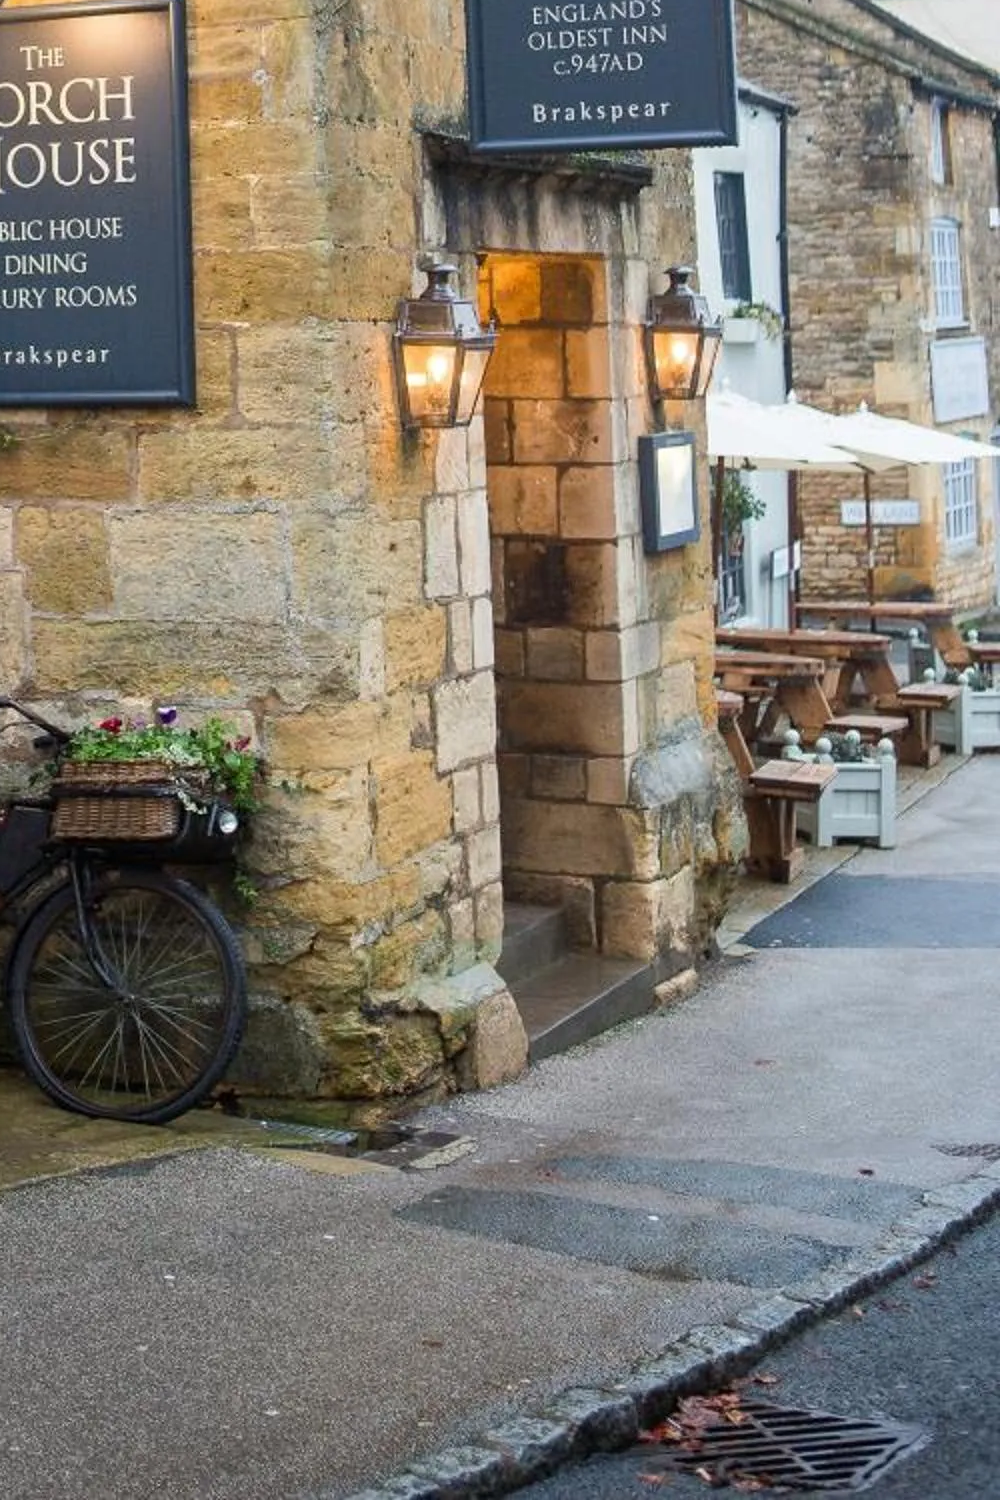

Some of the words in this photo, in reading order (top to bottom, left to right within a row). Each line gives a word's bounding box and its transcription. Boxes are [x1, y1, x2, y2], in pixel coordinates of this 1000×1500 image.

[527, 28, 612, 51] OLDEST
[622, 24, 667, 45] INN
[19, 45, 66, 71] THE
[532, 101, 671, 124] Brakspear
[49, 217, 123, 241] HOUSE
[4, 252, 88, 276] DINING
[55, 285, 137, 308] ROOMS
